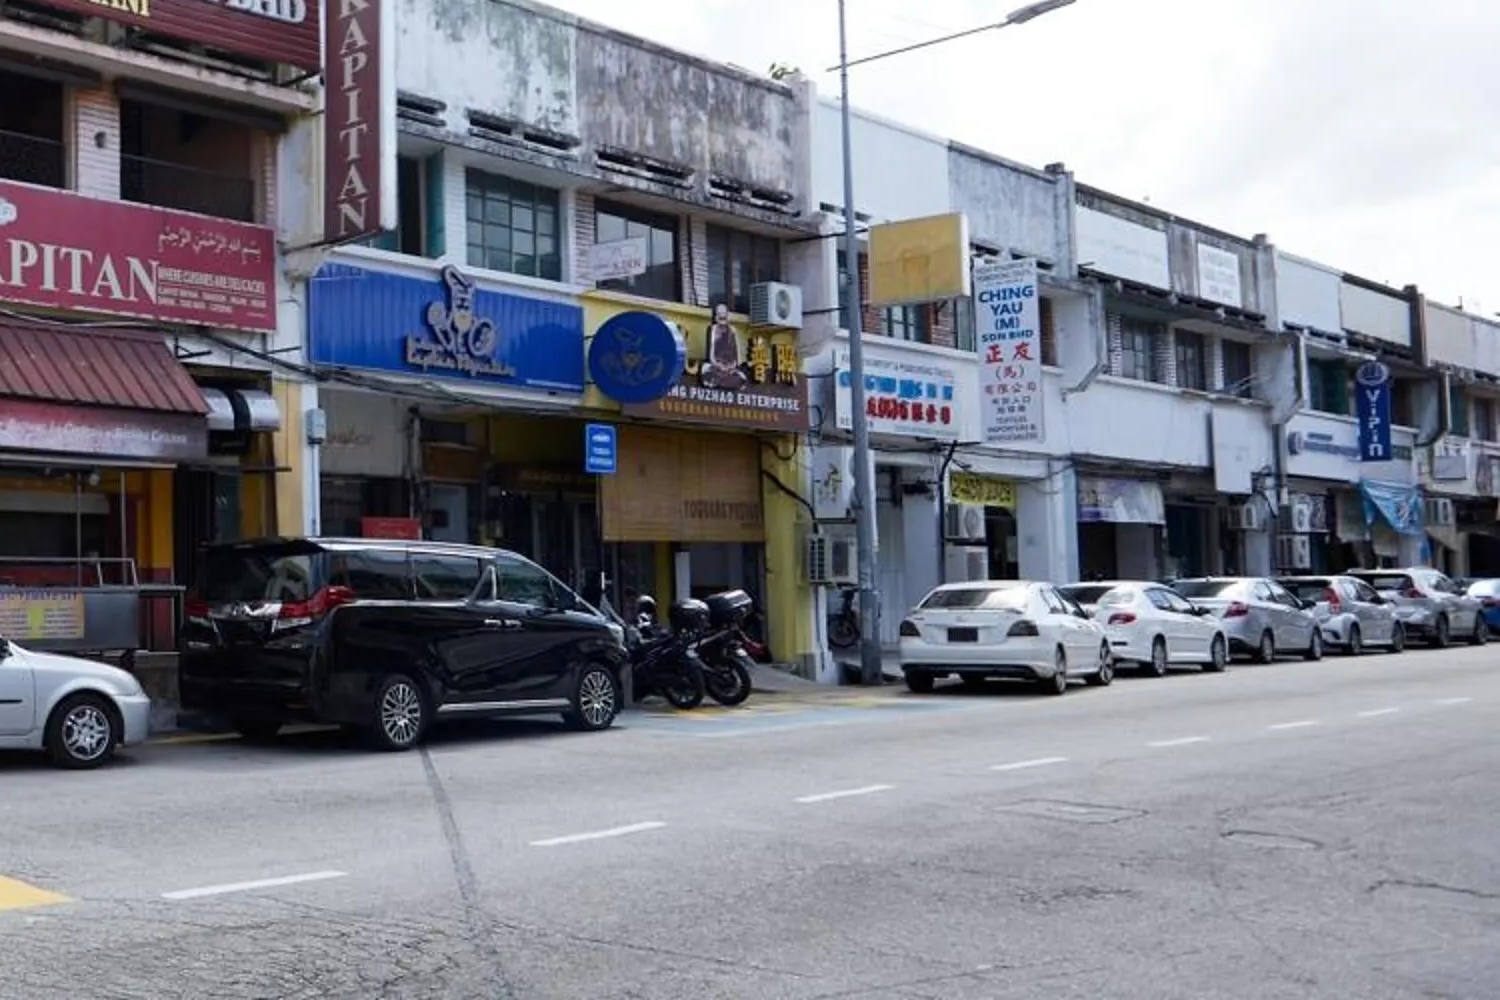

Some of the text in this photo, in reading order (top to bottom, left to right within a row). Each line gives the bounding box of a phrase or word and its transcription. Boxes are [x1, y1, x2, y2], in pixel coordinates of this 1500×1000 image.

[978, 285, 1034, 303] CHING
[990, 301, 1024, 316] YAU
[737, 393, 800, 412] ENTERPRISE
